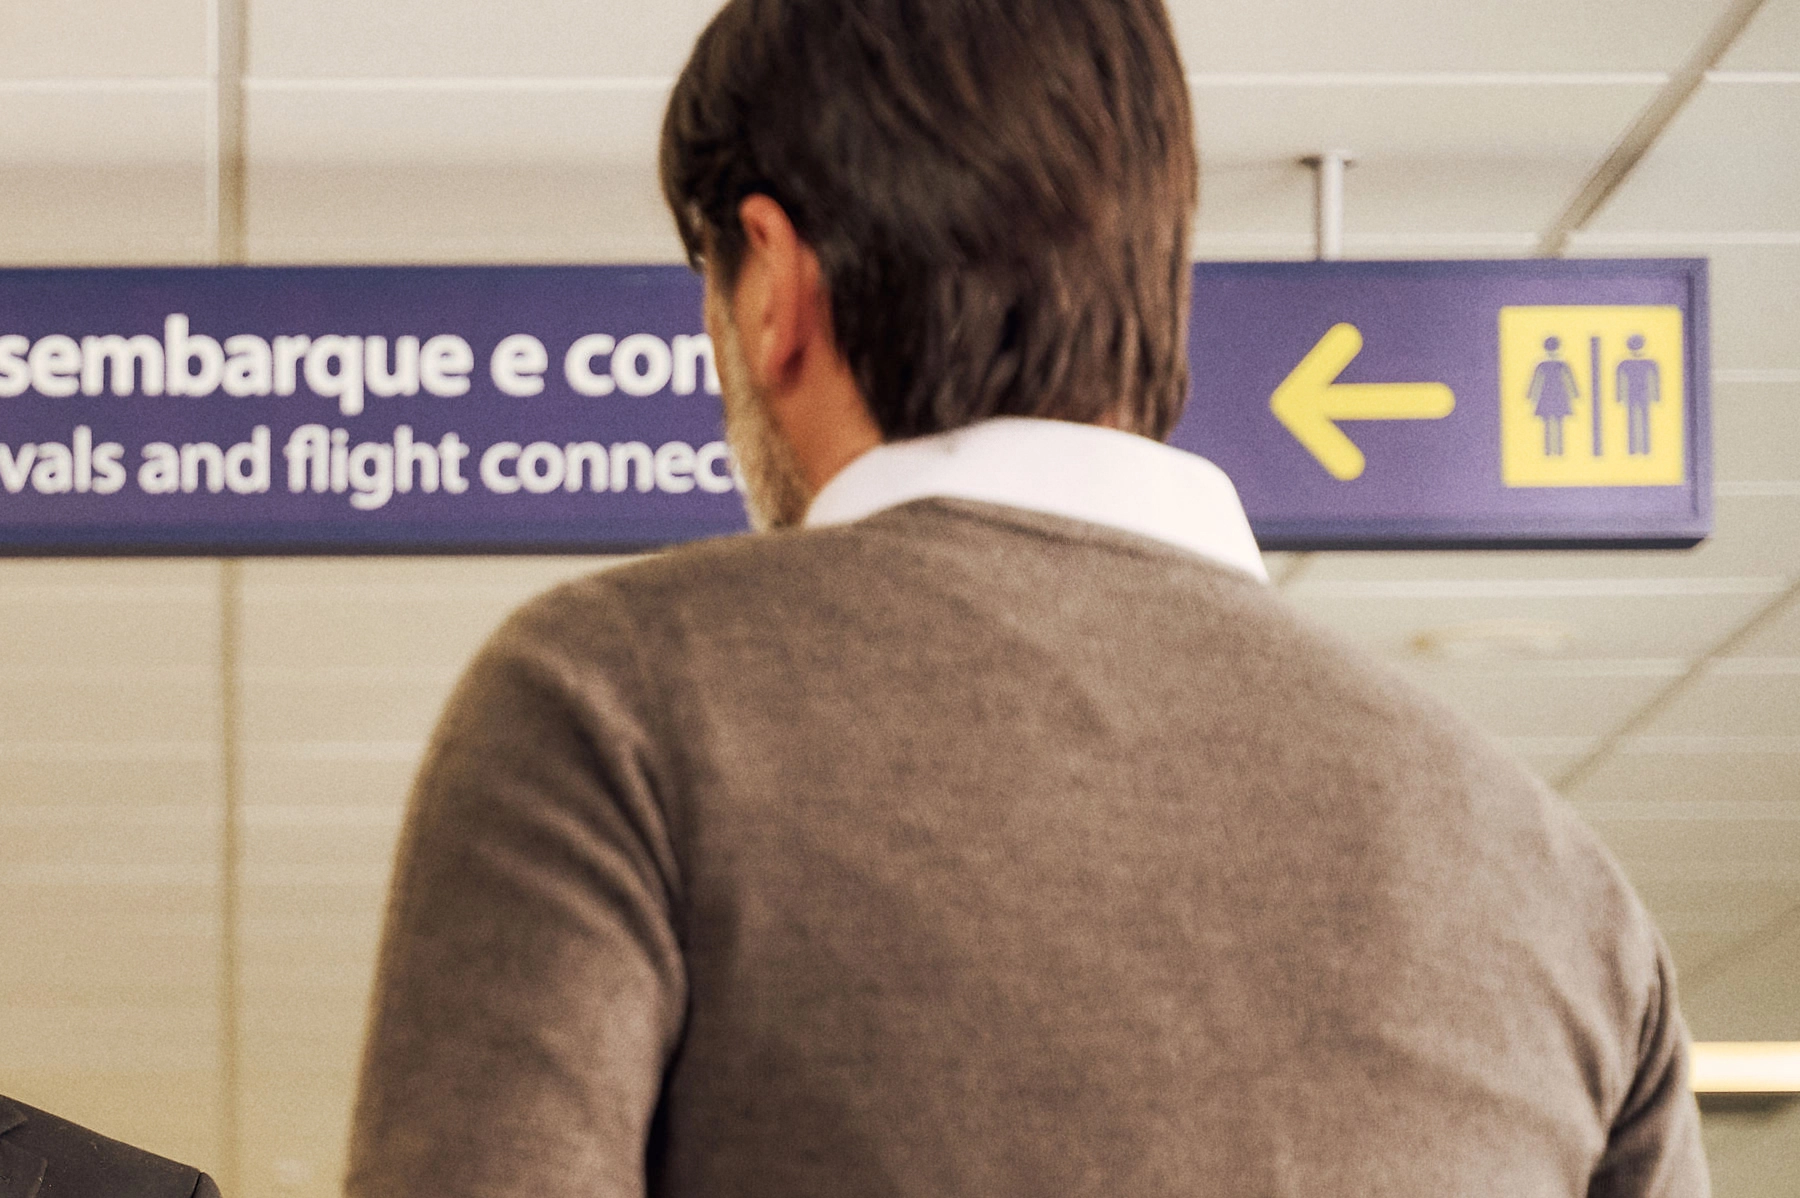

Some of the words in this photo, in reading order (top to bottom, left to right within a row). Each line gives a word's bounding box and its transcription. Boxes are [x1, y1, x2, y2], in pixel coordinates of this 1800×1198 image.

[490, 334, 549, 397] e
[138, 425, 271, 494] and
[284, 423, 470, 510] flight
